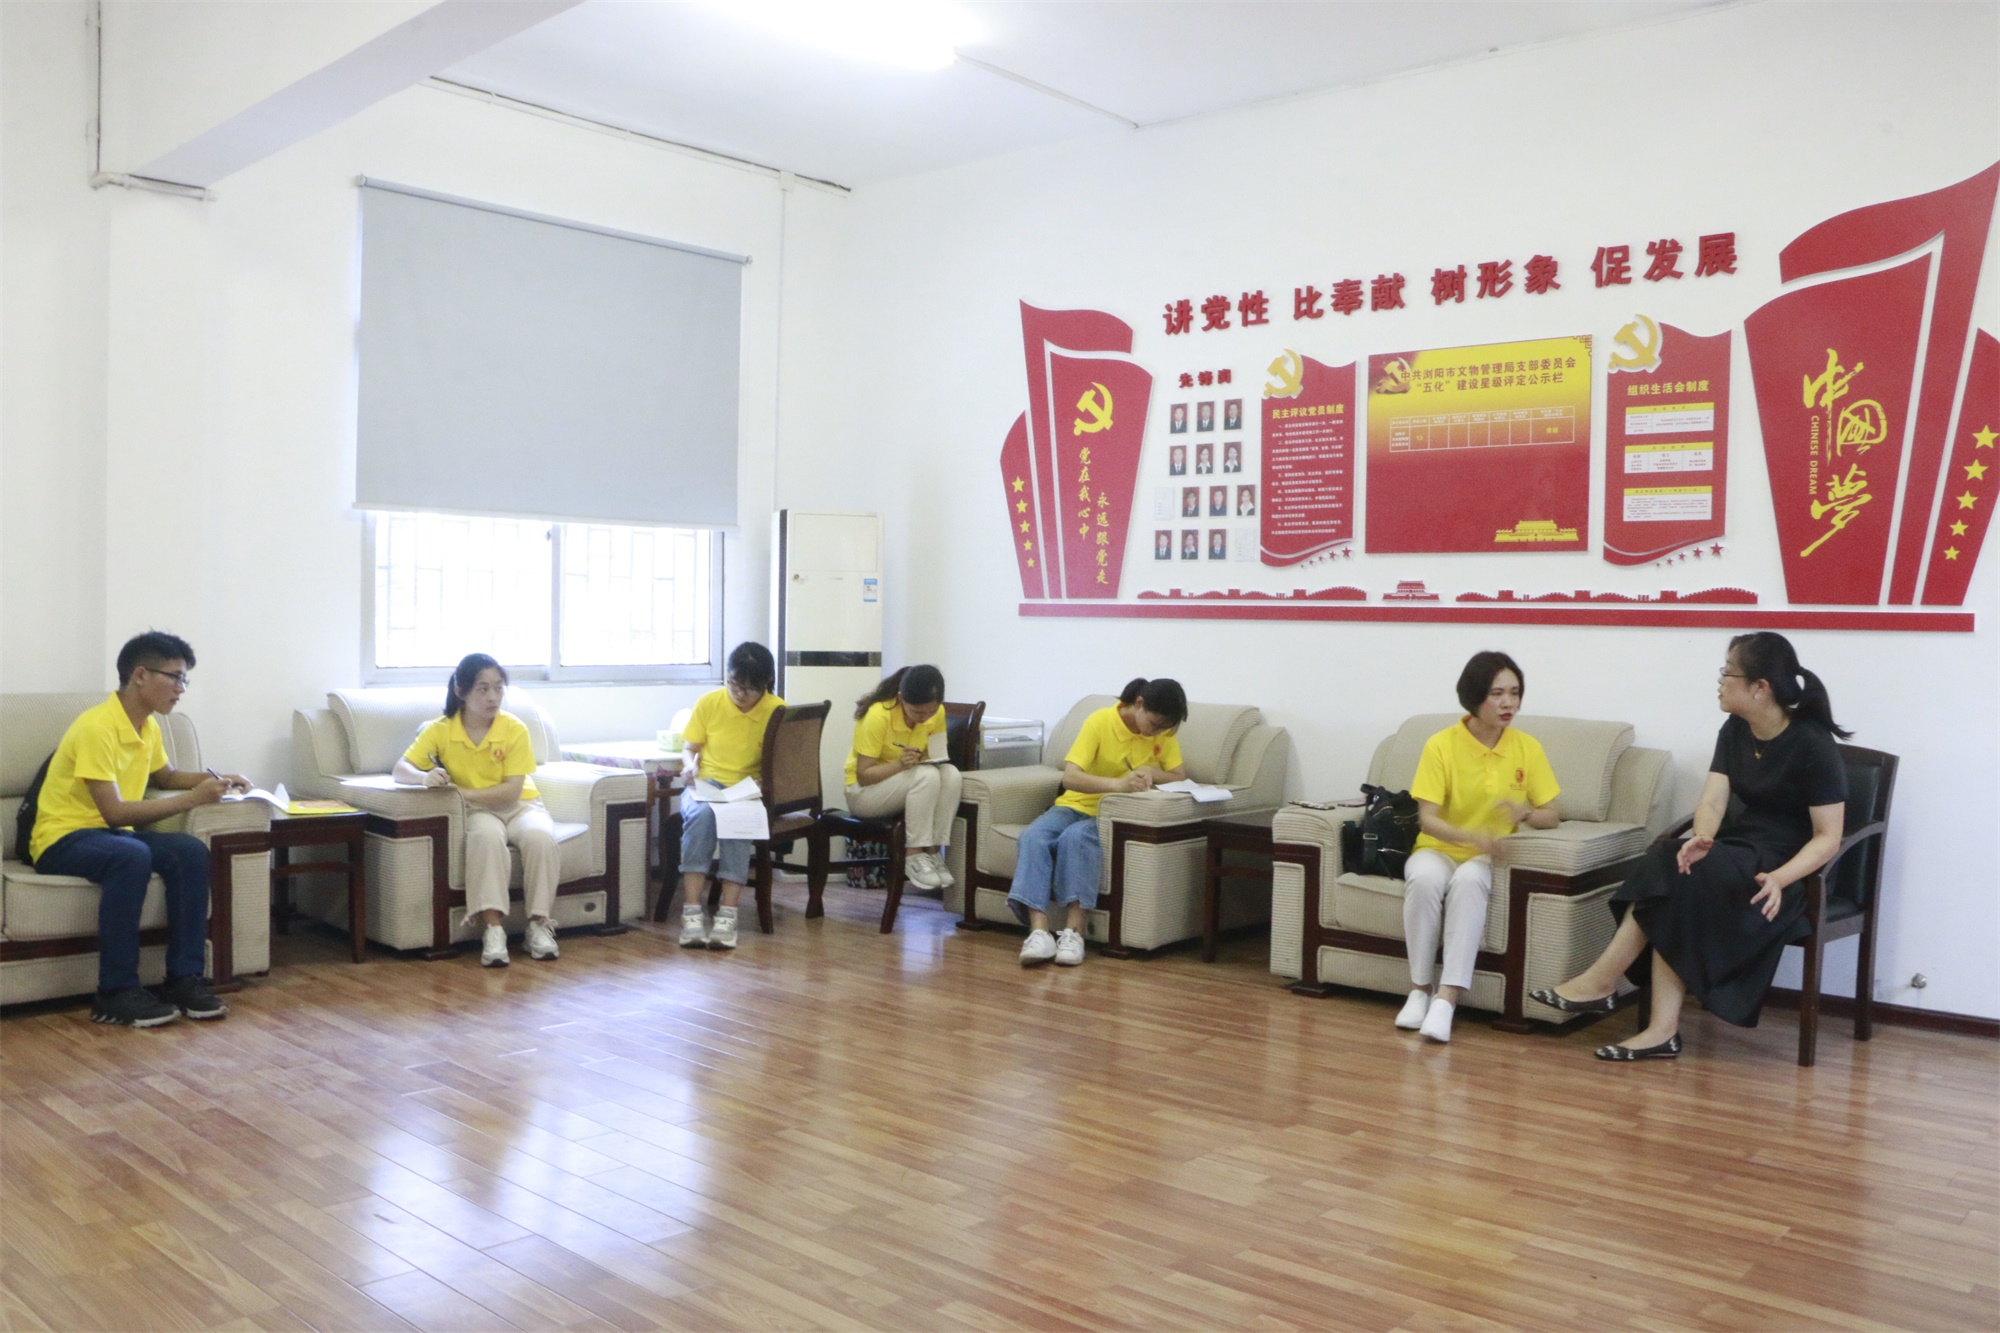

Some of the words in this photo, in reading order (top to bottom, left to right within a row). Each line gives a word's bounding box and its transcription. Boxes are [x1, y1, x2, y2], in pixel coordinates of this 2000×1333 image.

[1163, 289, 1270, 336] 讲党性
[1292, 273, 1406, 321] 比奉献
[1430, 254, 1561, 304] 树形象
[1590, 232, 1739, 288] 促发展
[1401, 356, 1577, 381] 中共浏阳市文物管理局支部委员会
[1626, 379, 1710, 396] 组织生活会制度
[1271, 403, 1345, 419] 民主评议党员制度
[1810, 415, 1820, 456] CHINESE
[1078, 446, 1092, 541] 党在我心中
[1809, 460, 1818, 495] DREAM
[1095, 491, 1110, 585] 永远跟党走
